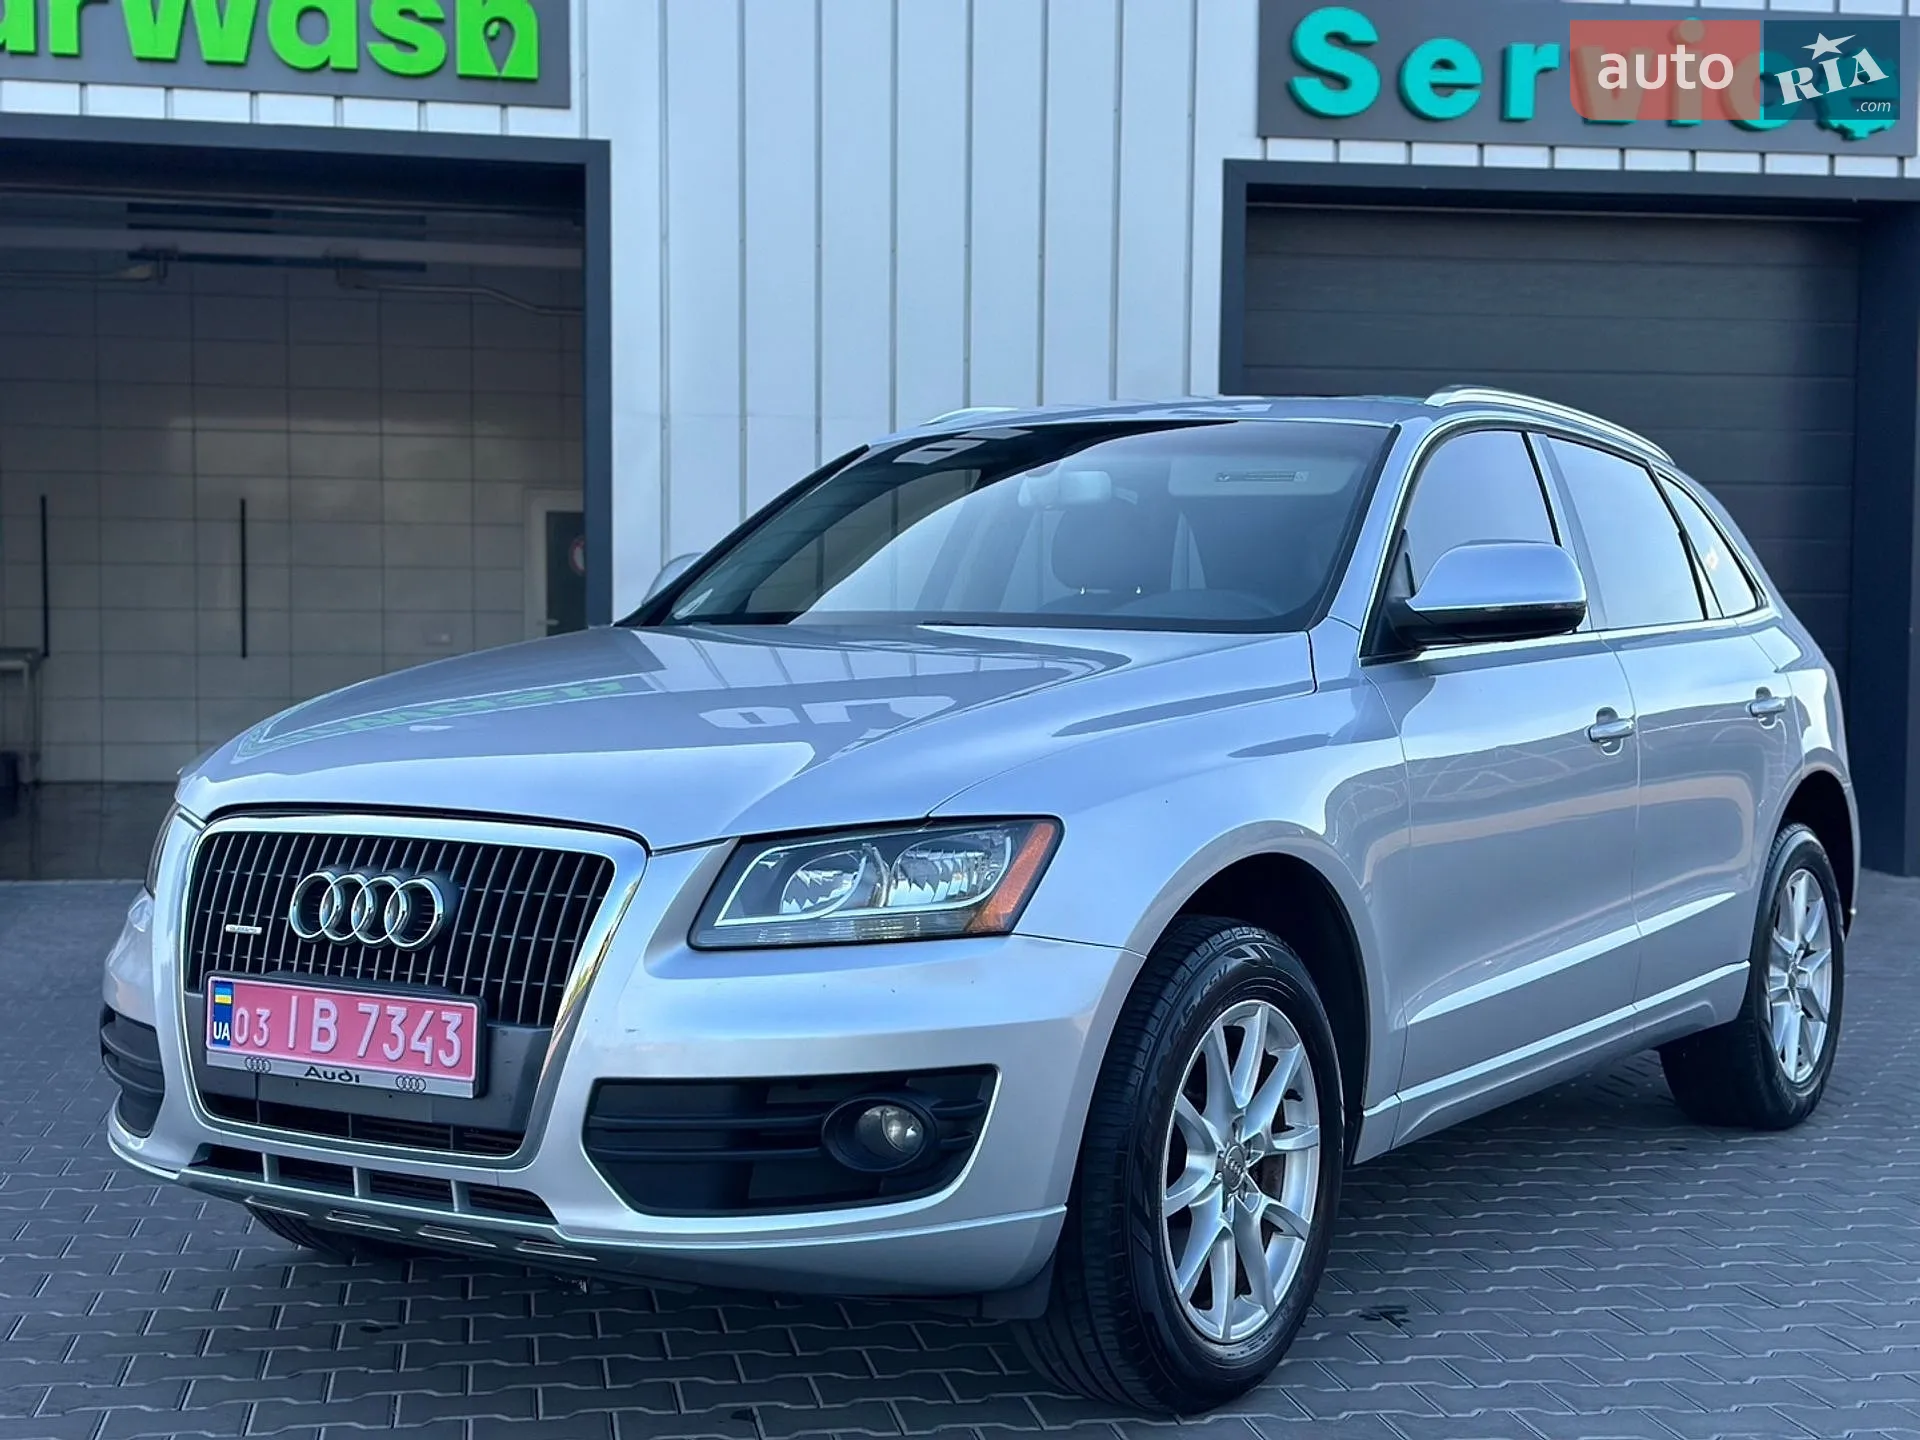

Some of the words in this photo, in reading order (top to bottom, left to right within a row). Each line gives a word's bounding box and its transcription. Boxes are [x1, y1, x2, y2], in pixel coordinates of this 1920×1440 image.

[213, 1020, 231, 1042] UA
[234, 1007, 272, 1047] 03
[287, 995, 339, 1054] IB
[356, 1001, 463, 1068] 7343
[304, 1065, 361, 1084] Audi
